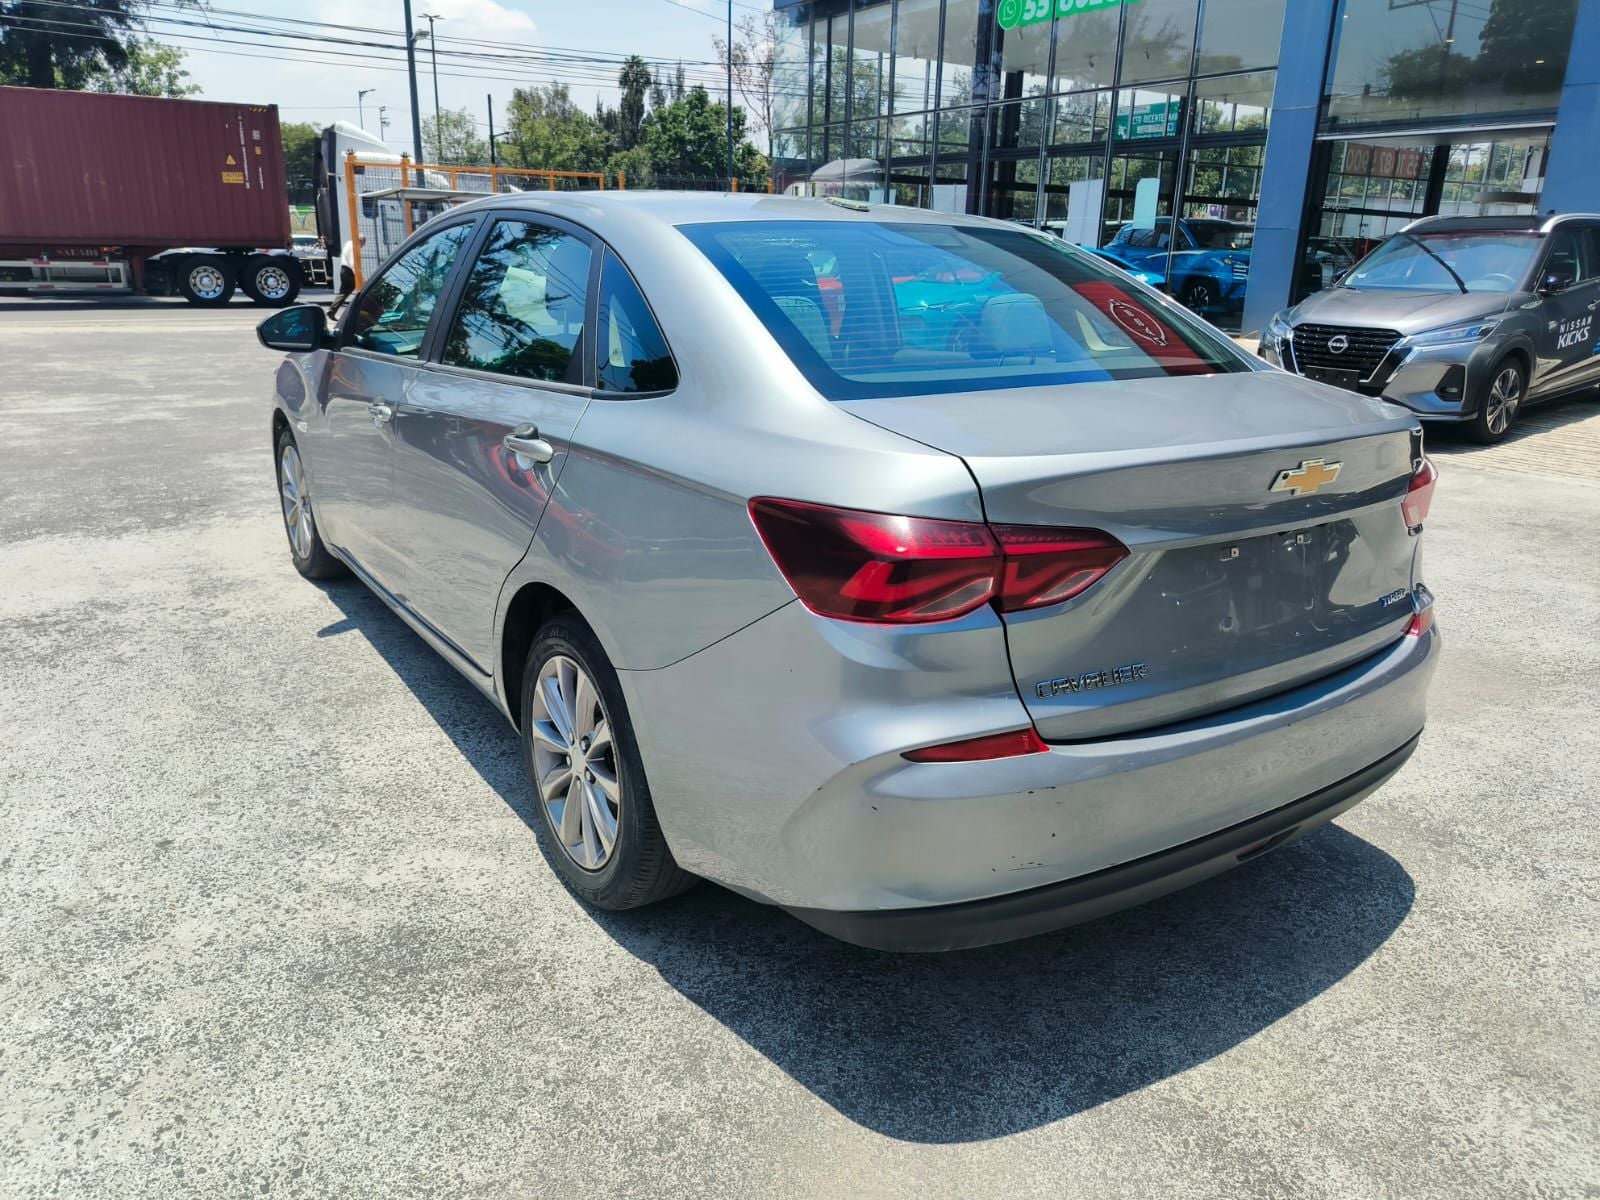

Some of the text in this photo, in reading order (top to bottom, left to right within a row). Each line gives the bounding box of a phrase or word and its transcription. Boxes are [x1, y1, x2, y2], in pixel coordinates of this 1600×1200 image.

[1560, 315, 1592, 333] NISSAN
[1557, 326, 1590, 350] KICKS
[1036, 663, 1148, 699] CAVALIER
